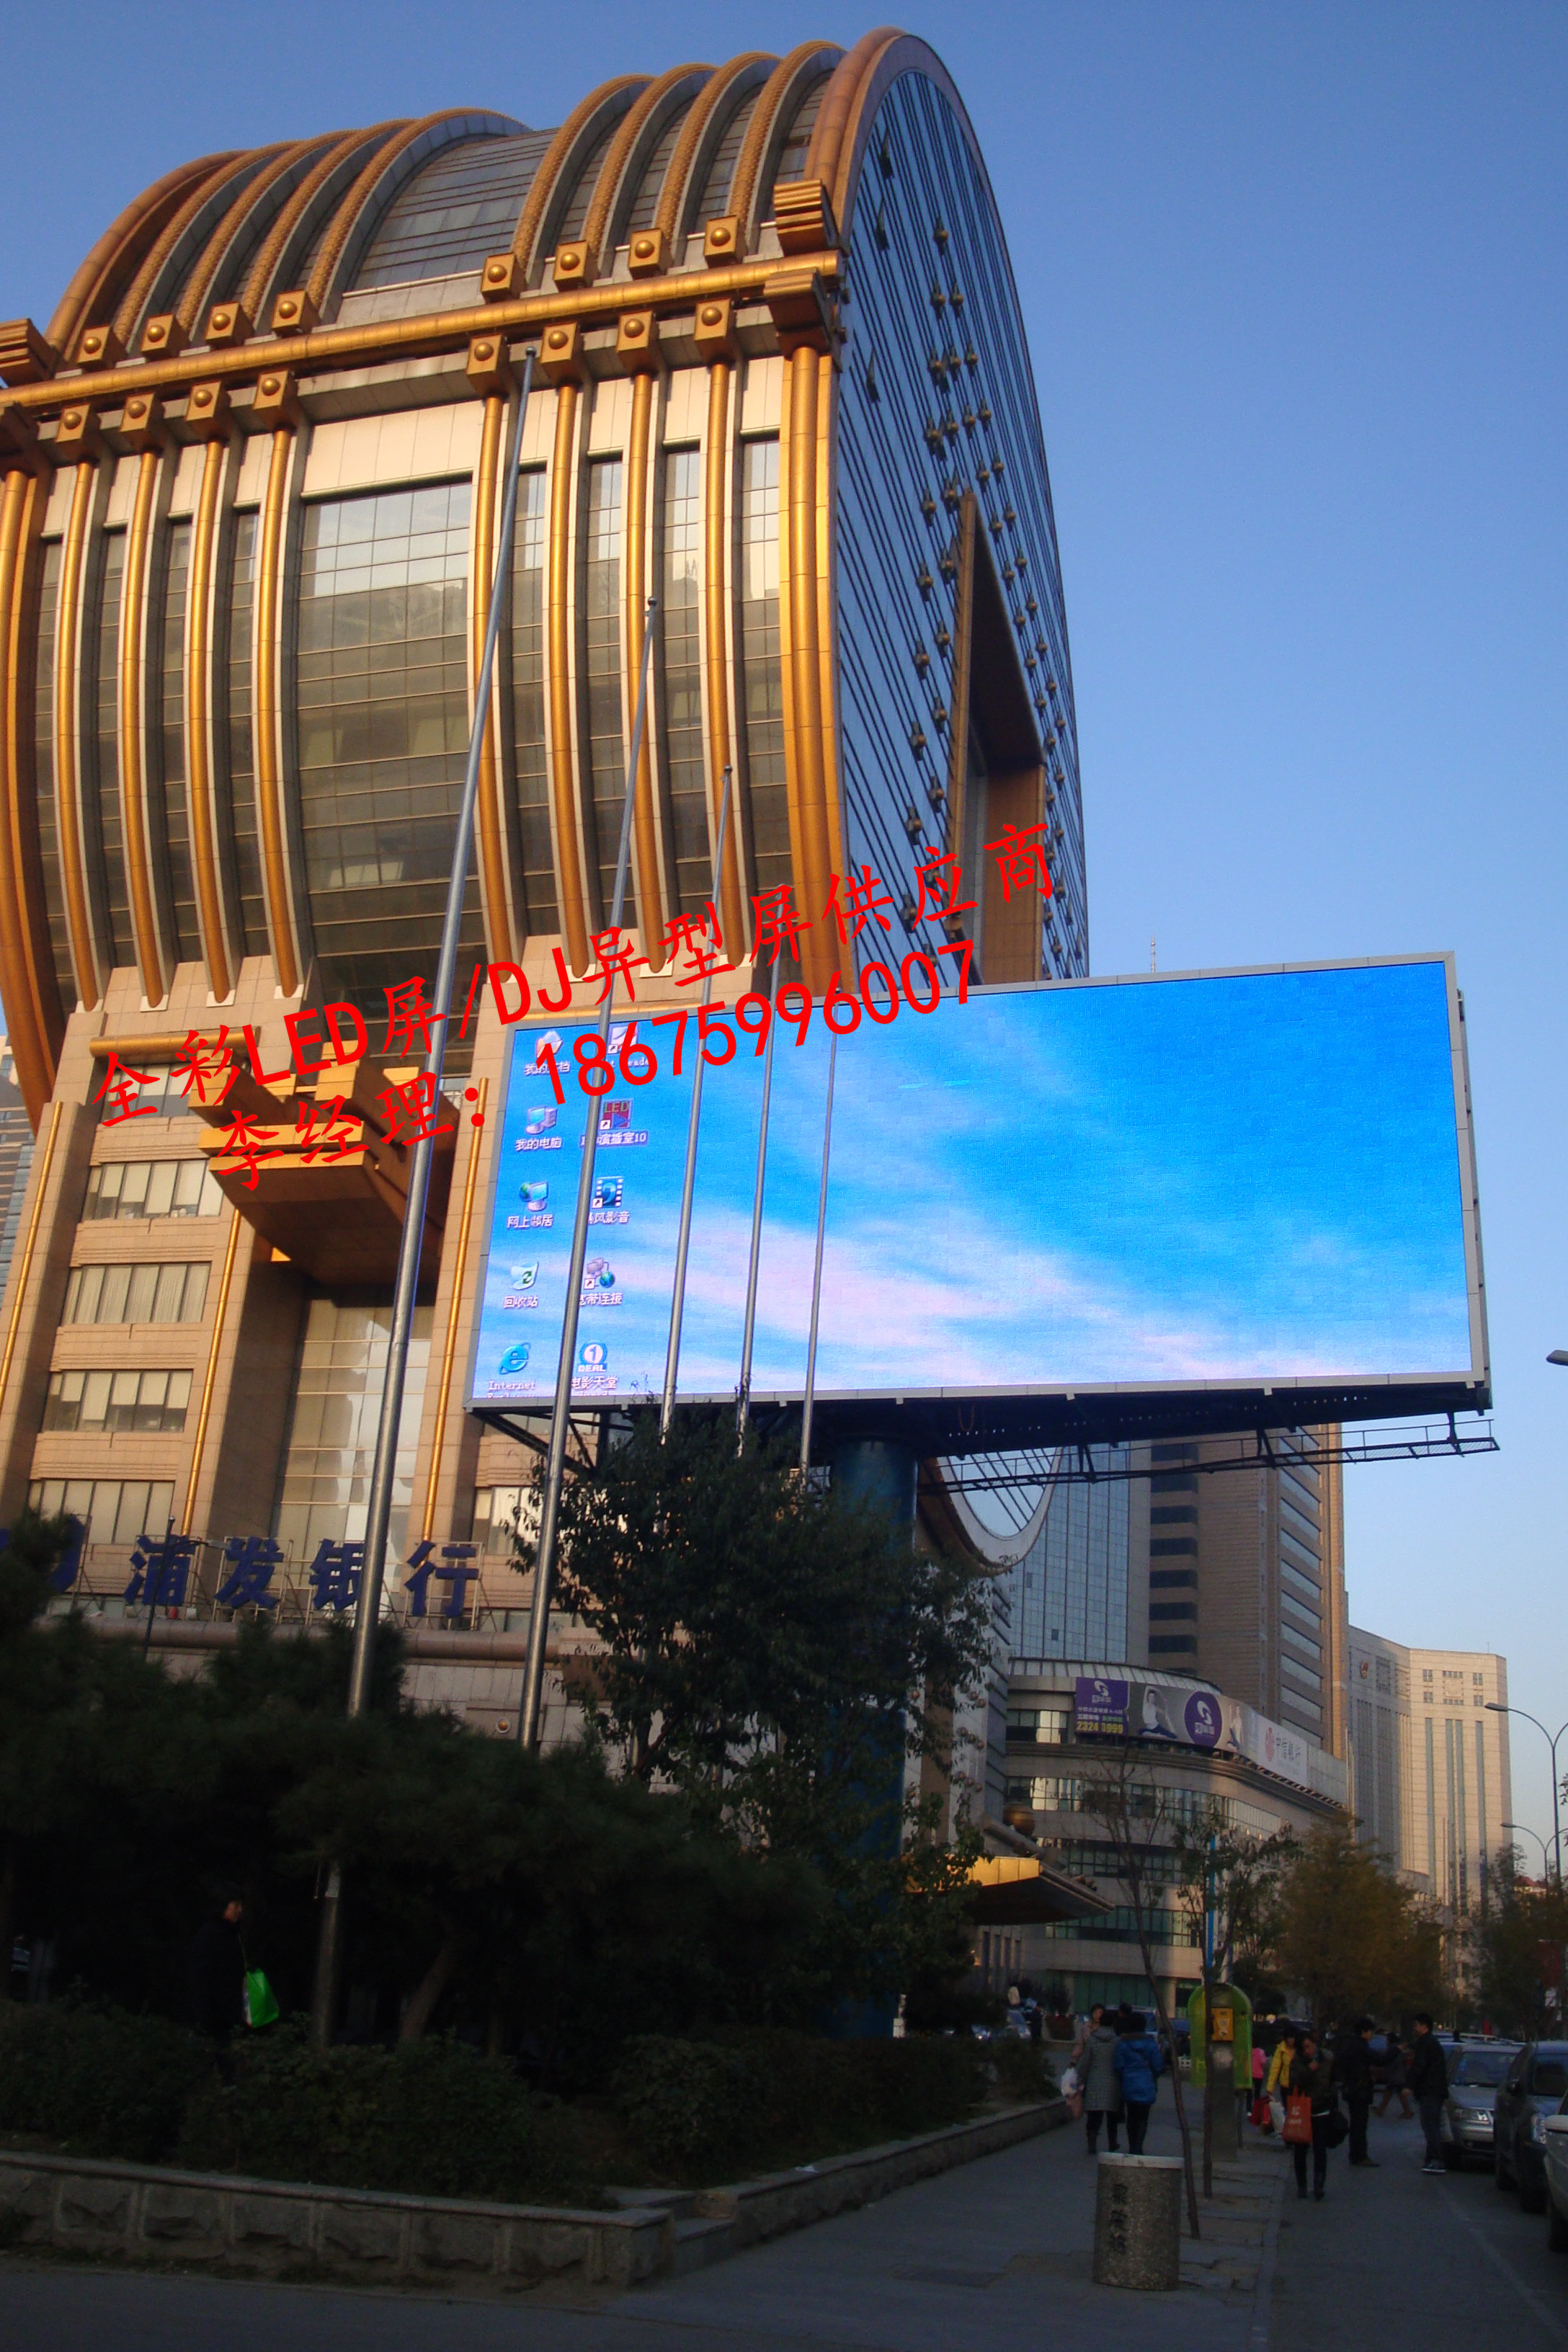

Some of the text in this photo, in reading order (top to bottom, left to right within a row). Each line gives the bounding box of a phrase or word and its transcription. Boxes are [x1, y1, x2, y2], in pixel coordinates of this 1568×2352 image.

[524, 1061, 571, 1076] 我的档
[604, 1100, 630, 1113] LED
[515, 1136, 562, 1152] 我的电脑
[580, 1131, 647, 1146] LD演播室10
[507, 1213, 554, 1229] 网上邻居
[504, 1296, 539, 1309] 回收站
[578, 1364, 607, 1373] REAL
[488, 1379, 536, 1391] Internet
[571, 1376, 618, 1390] 电影天堂
[124, 1533, 479, 1618] 浦发银行
